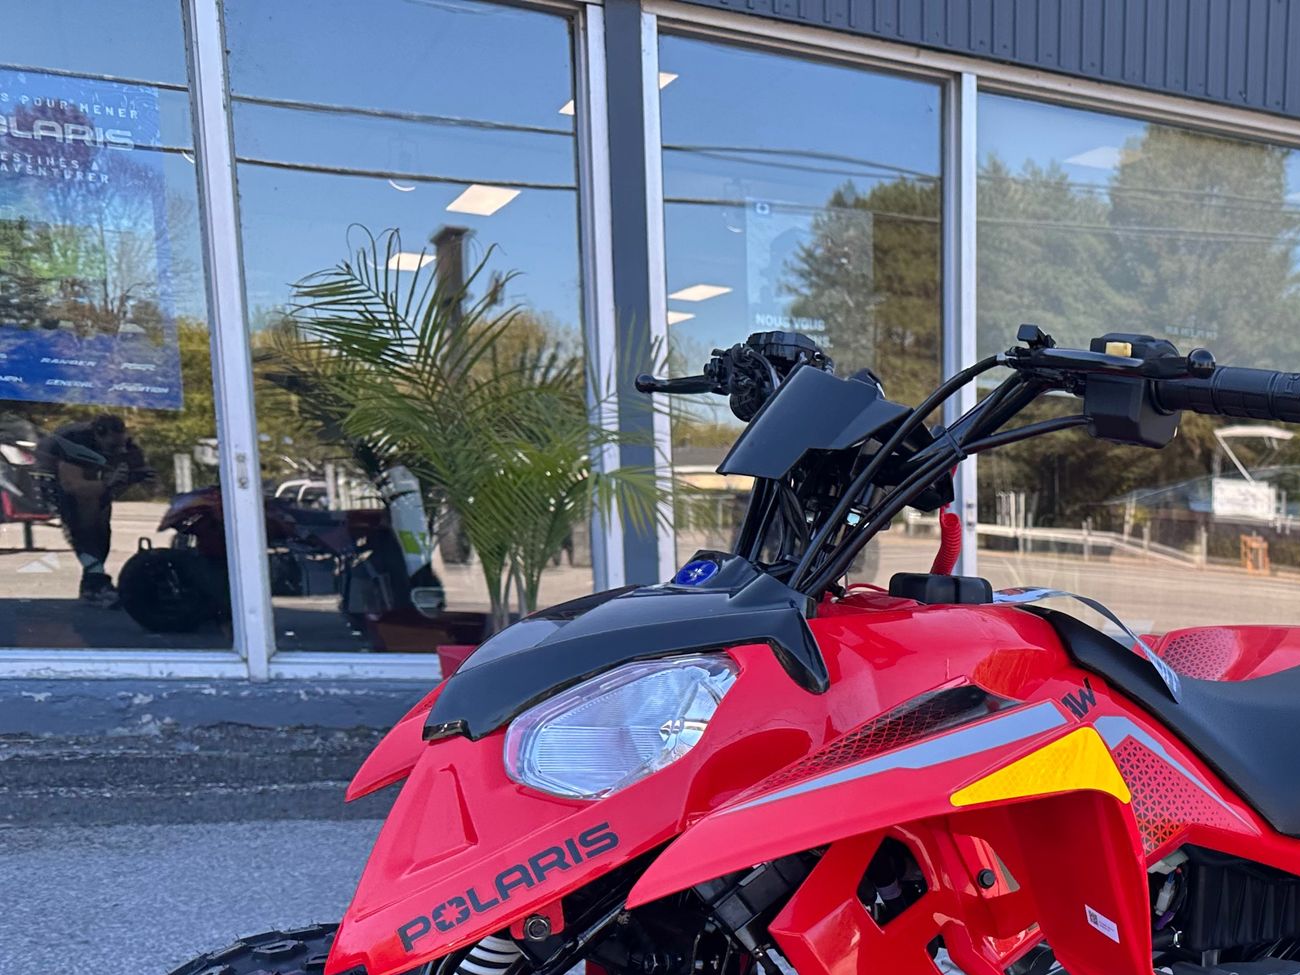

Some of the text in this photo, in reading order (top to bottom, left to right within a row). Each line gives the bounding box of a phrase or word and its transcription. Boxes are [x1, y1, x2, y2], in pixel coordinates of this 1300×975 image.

[20, 94, 68, 110] POUR
[79, 103, 138, 120] MENER
[0, 114, 134, 151] LARIS
[755, 313, 790, 329] NOUS
[396, 821, 619, 953] POLARIS
